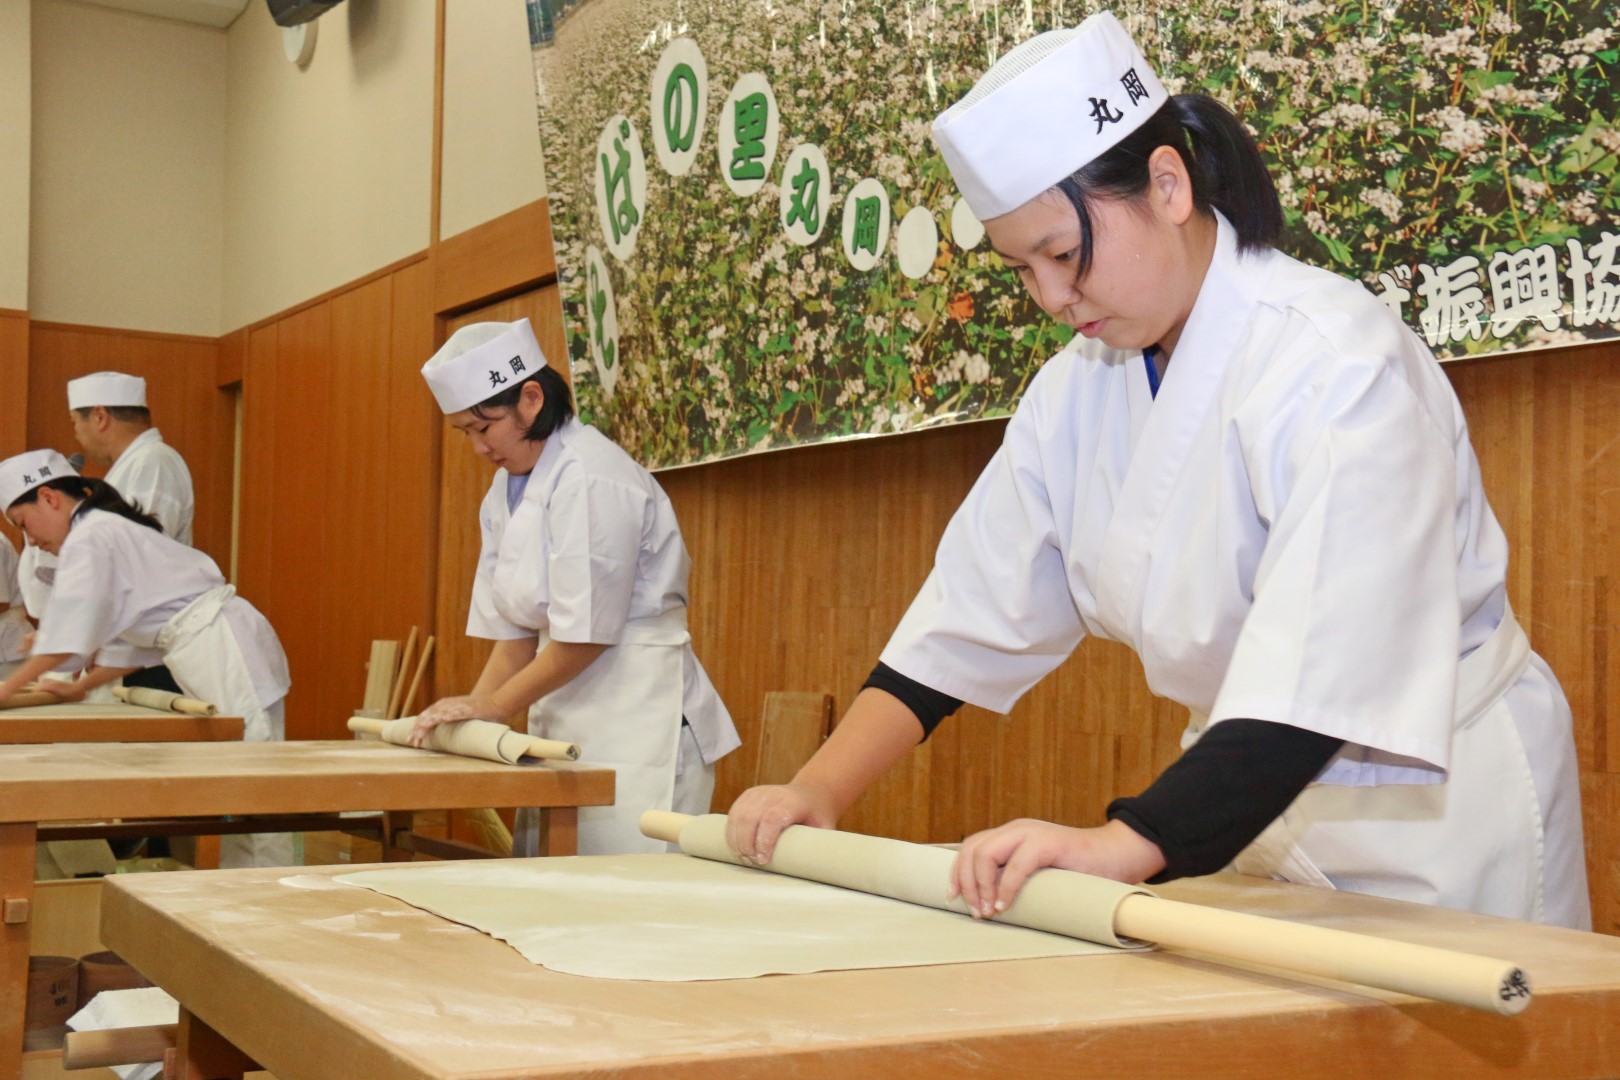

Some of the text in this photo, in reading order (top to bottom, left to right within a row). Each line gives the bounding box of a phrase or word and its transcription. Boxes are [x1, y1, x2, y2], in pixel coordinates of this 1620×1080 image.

[1087, 67, 1150, 135] 丸岡
[488, 355, 527, 389] 丸岡
[23, 466, 53, 487] 丸岡
